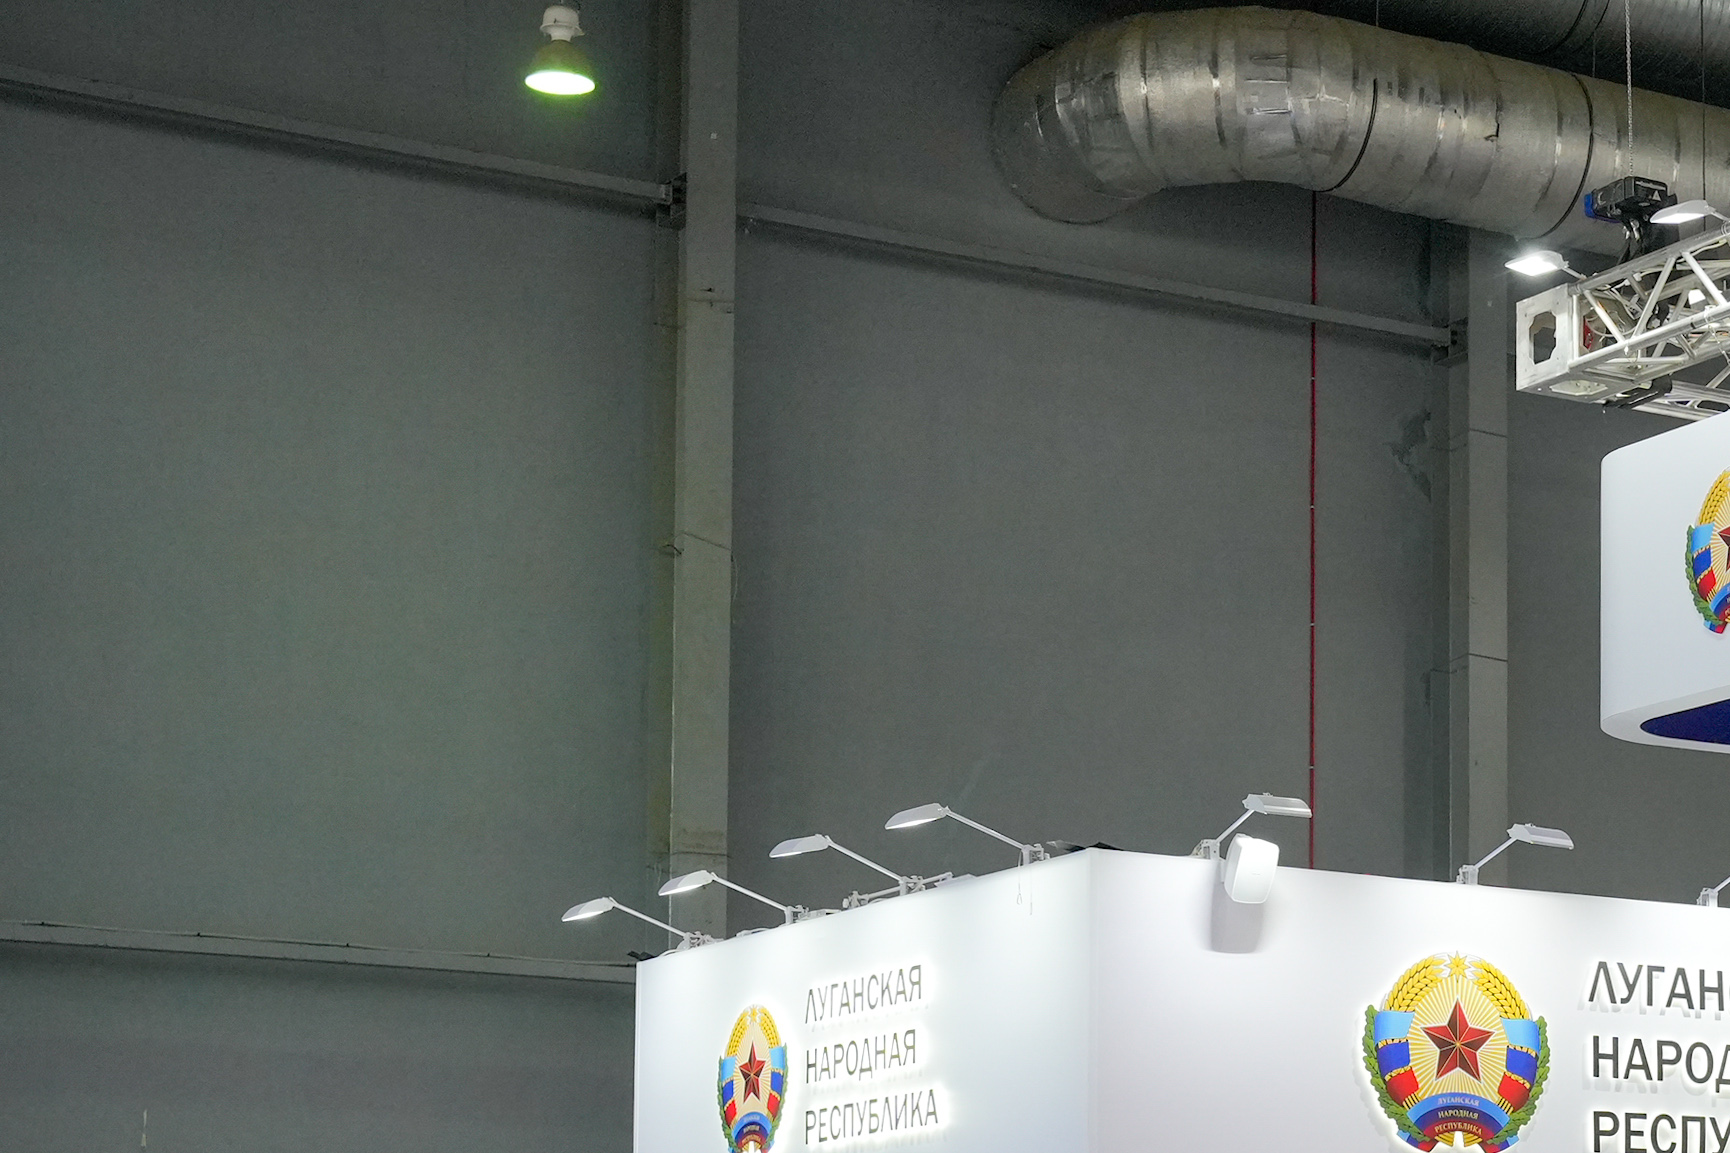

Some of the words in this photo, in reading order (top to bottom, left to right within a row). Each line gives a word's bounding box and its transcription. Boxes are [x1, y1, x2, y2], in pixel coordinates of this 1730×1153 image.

[805, 965, 922, 1024] ЛУГАНСКАЯ
[806, 1029, 916, 1084] НАРОДНАЯ
[805, 1089, 938, 1145] РЕСПУБЛИКА
[1434, 1122, 1482, 1135] РЕСПУБЛИКА
[1437, 1109, 1479, 1120] НАРОДНАЯ
